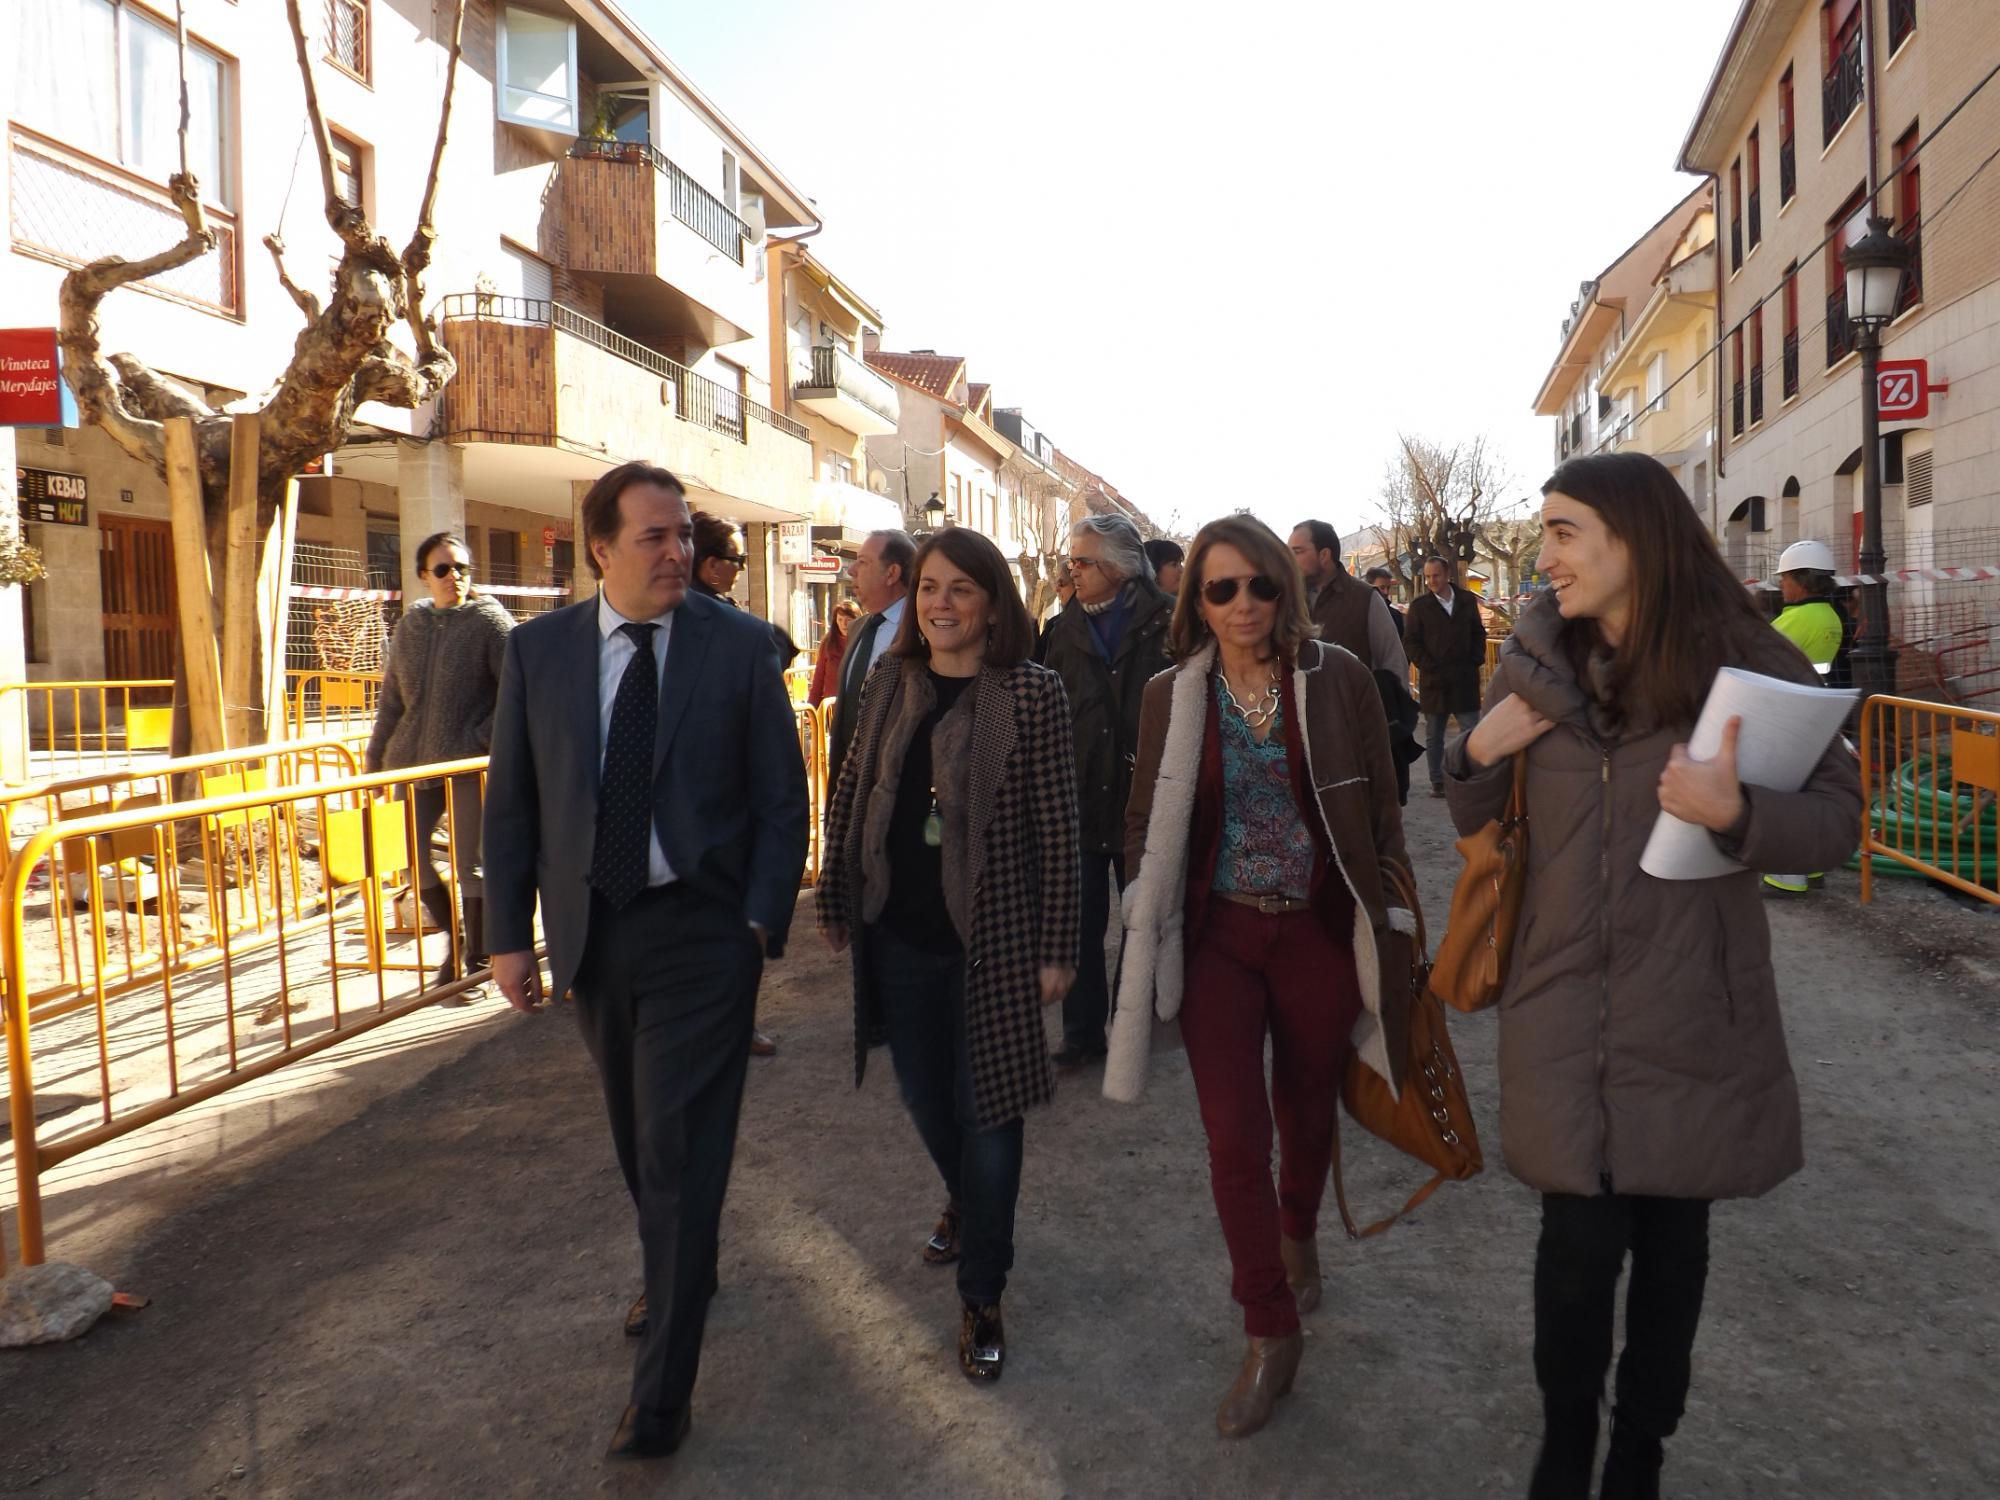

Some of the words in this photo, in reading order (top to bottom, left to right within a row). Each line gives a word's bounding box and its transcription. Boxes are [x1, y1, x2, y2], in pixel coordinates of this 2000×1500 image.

[0, 357, 49, 371] Vinoteca
[0, 377, 57, 397] Merydajes
[47, 475, 86, 499] KEBAB
[58, 502, 83, 522] HUT
[781, 525, 805, 537] BAZAR
